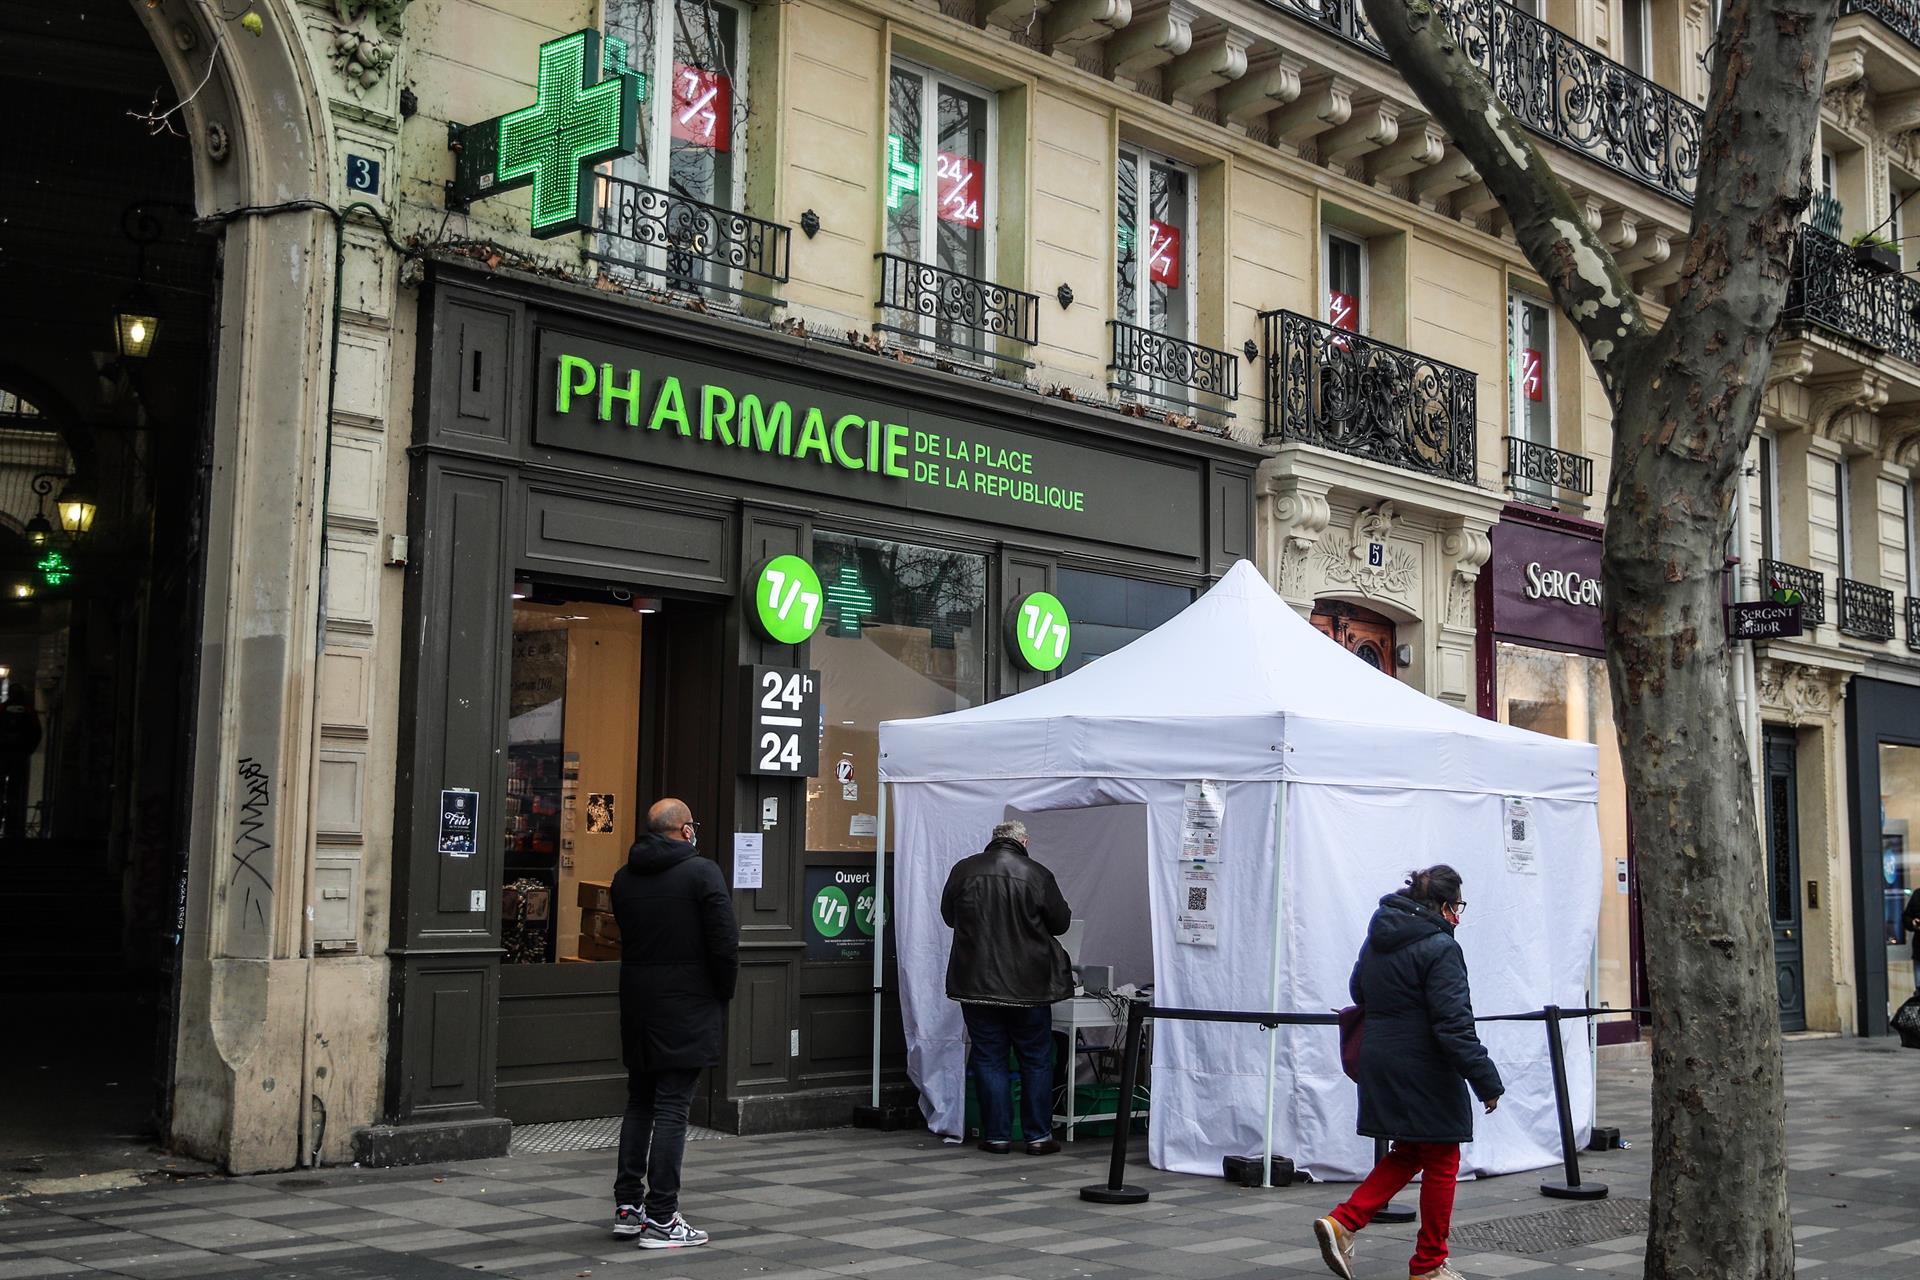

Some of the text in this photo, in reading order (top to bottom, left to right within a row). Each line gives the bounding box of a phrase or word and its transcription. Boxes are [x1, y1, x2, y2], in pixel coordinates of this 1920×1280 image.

[679, 69, 718, 138] 7/7
[355, 159, 371, 189] 3
[936, 154, 979, 224] 24/24
[1149, 224, 1172, 277] 7/7
[1522, 352, 1538, 393] 7/7
[556, 354, 909, 478] PHARMACIE
[915, 431, 1033, 475] DE LA PLACE
[914, 461, 1084, 512] DE LA REPUBLIQUE
[1372, 544, 1380, 565] 5
[766, 569, 819, 631] 7/7
[1526, 561, 1602, 607] SeRGeN
[1024, 604, 1067, 659] 7/7
[761, 671, 813, 711] 24h
[759, 731, 802, 772] 24
[835, 870, 870, 884] Ouvert
[817, 896, 848, 928] 7/7
